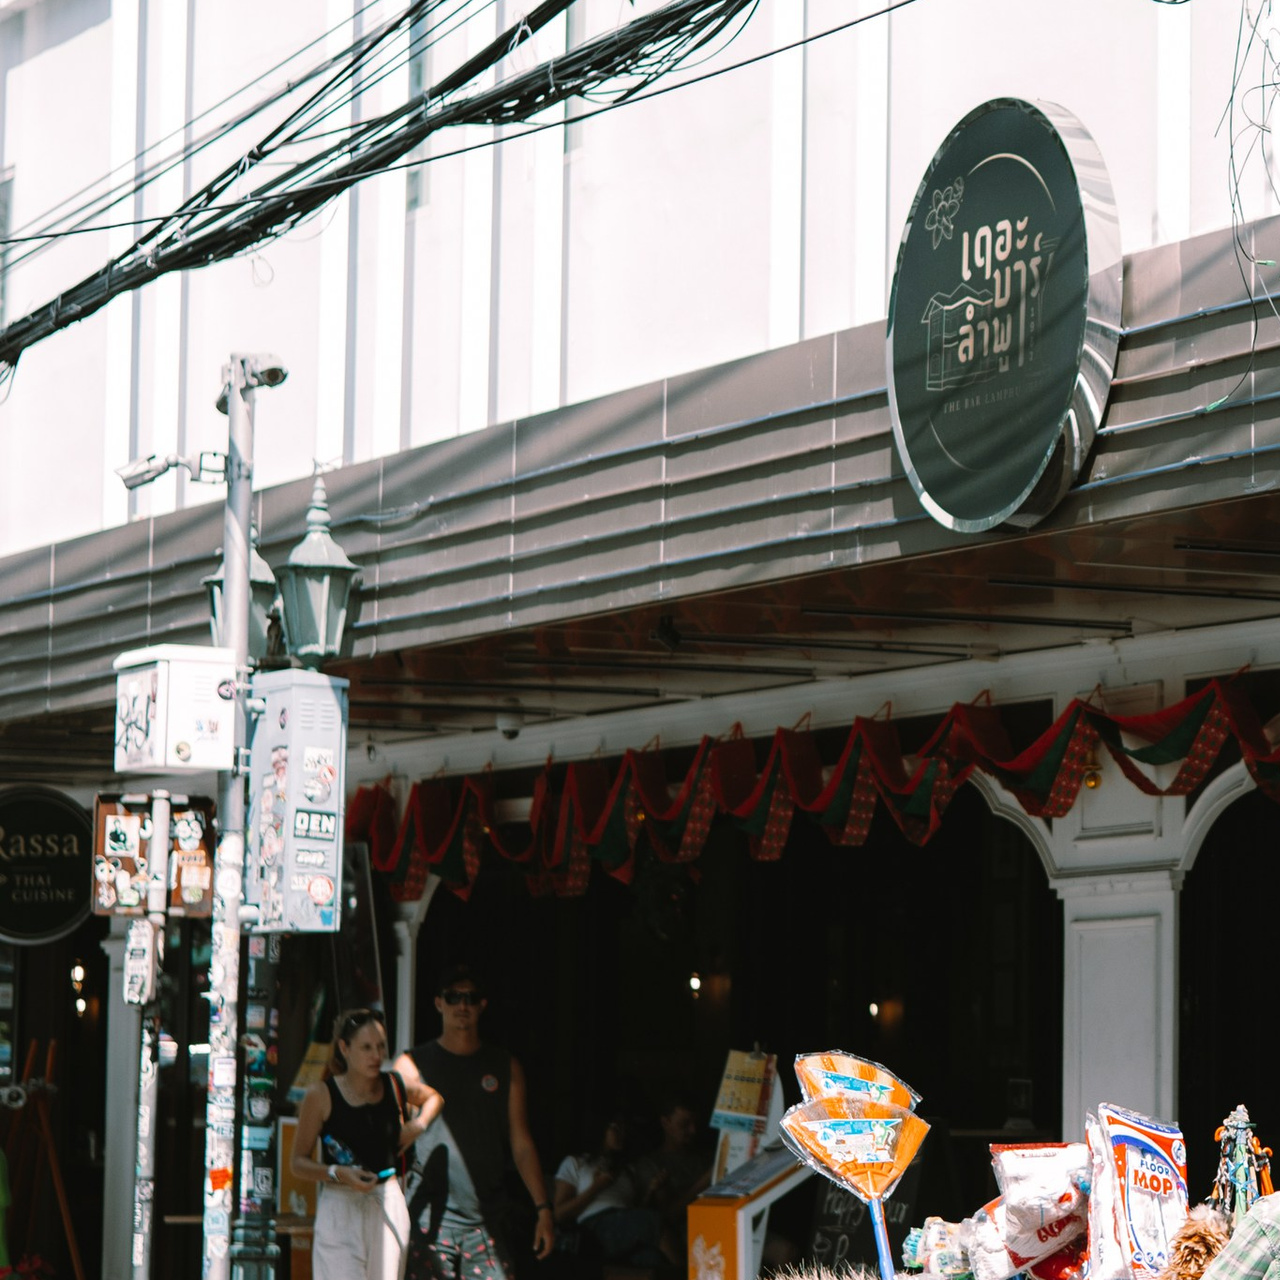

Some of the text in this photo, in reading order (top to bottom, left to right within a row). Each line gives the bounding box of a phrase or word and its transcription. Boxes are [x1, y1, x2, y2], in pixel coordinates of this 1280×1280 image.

[14, 874, 52, 888] THAI
[11, 888, 76, 904] CUISINE
[1139, 1158, 1171, 1178] FLOOR
[1132, 1169, 1174, 1196] MOP
